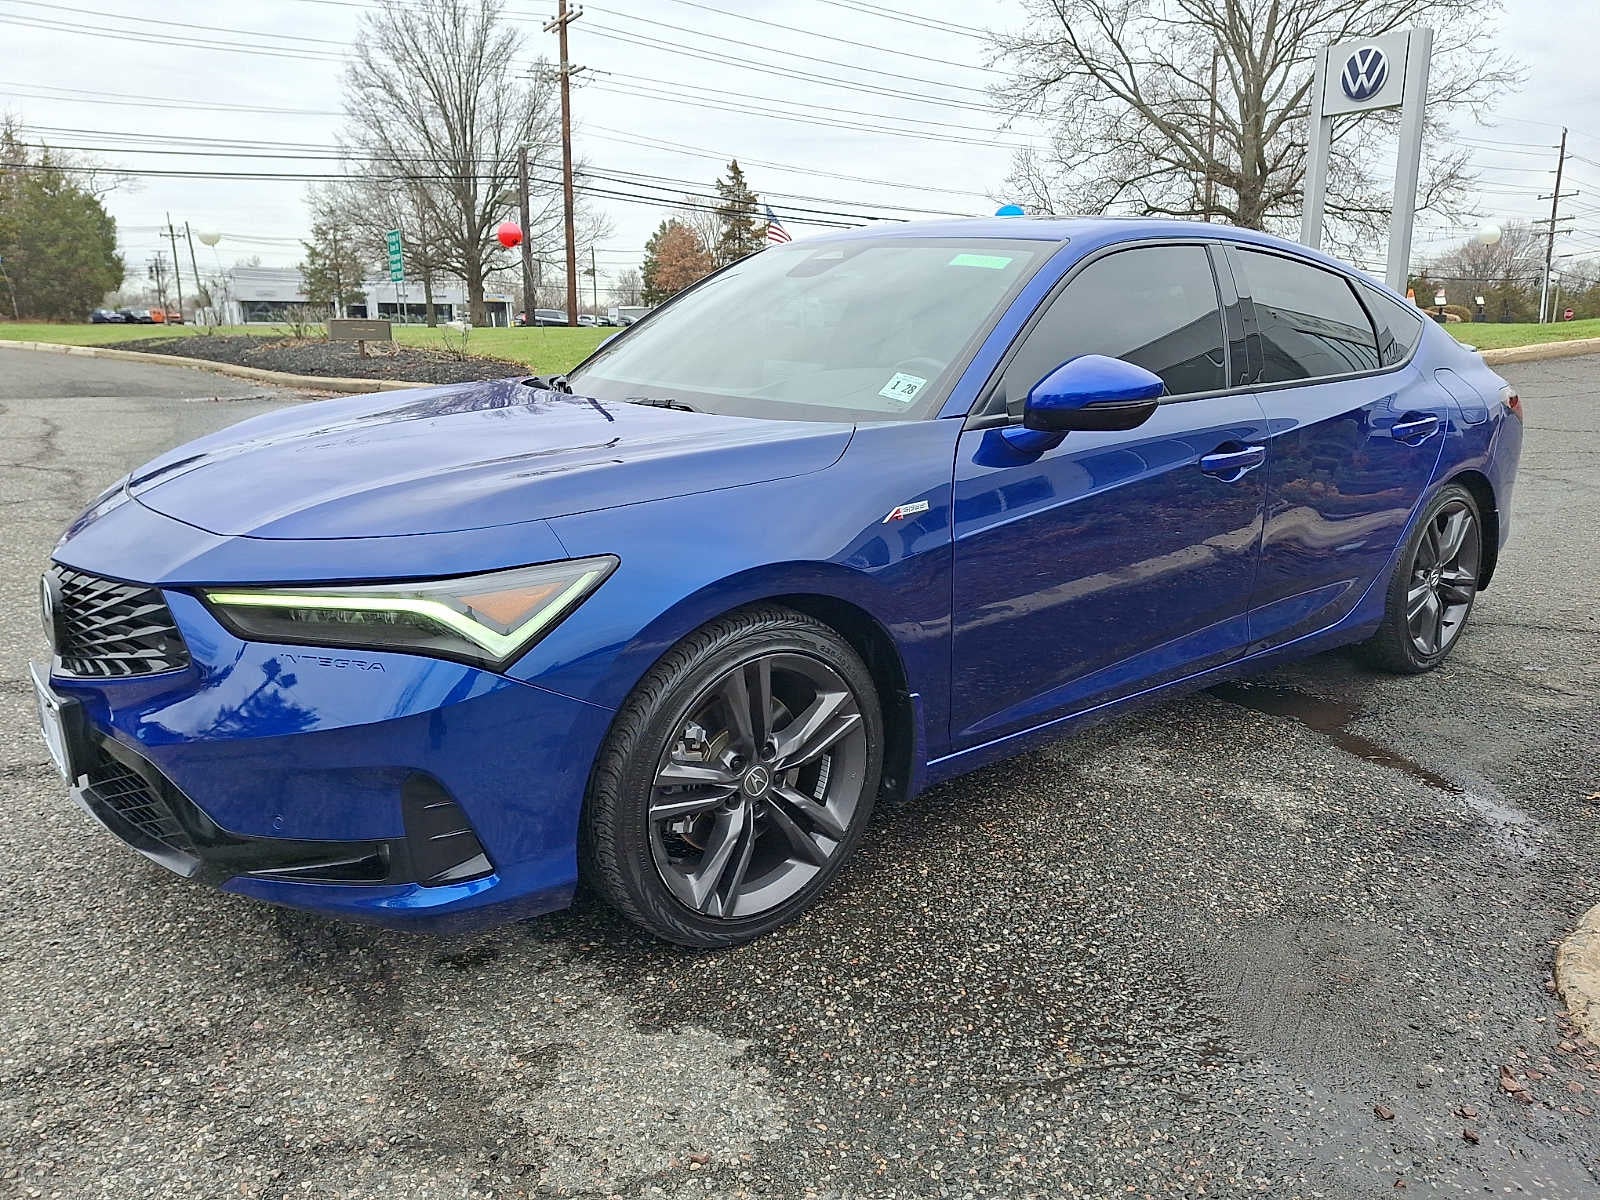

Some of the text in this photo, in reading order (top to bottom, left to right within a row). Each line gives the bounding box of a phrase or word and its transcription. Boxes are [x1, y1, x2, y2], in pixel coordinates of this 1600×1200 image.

[1342, 47, 1387, 98] VW
[891, 380, 918, 395] 1 28
[279, 652, 386, 673] INTEGRA
